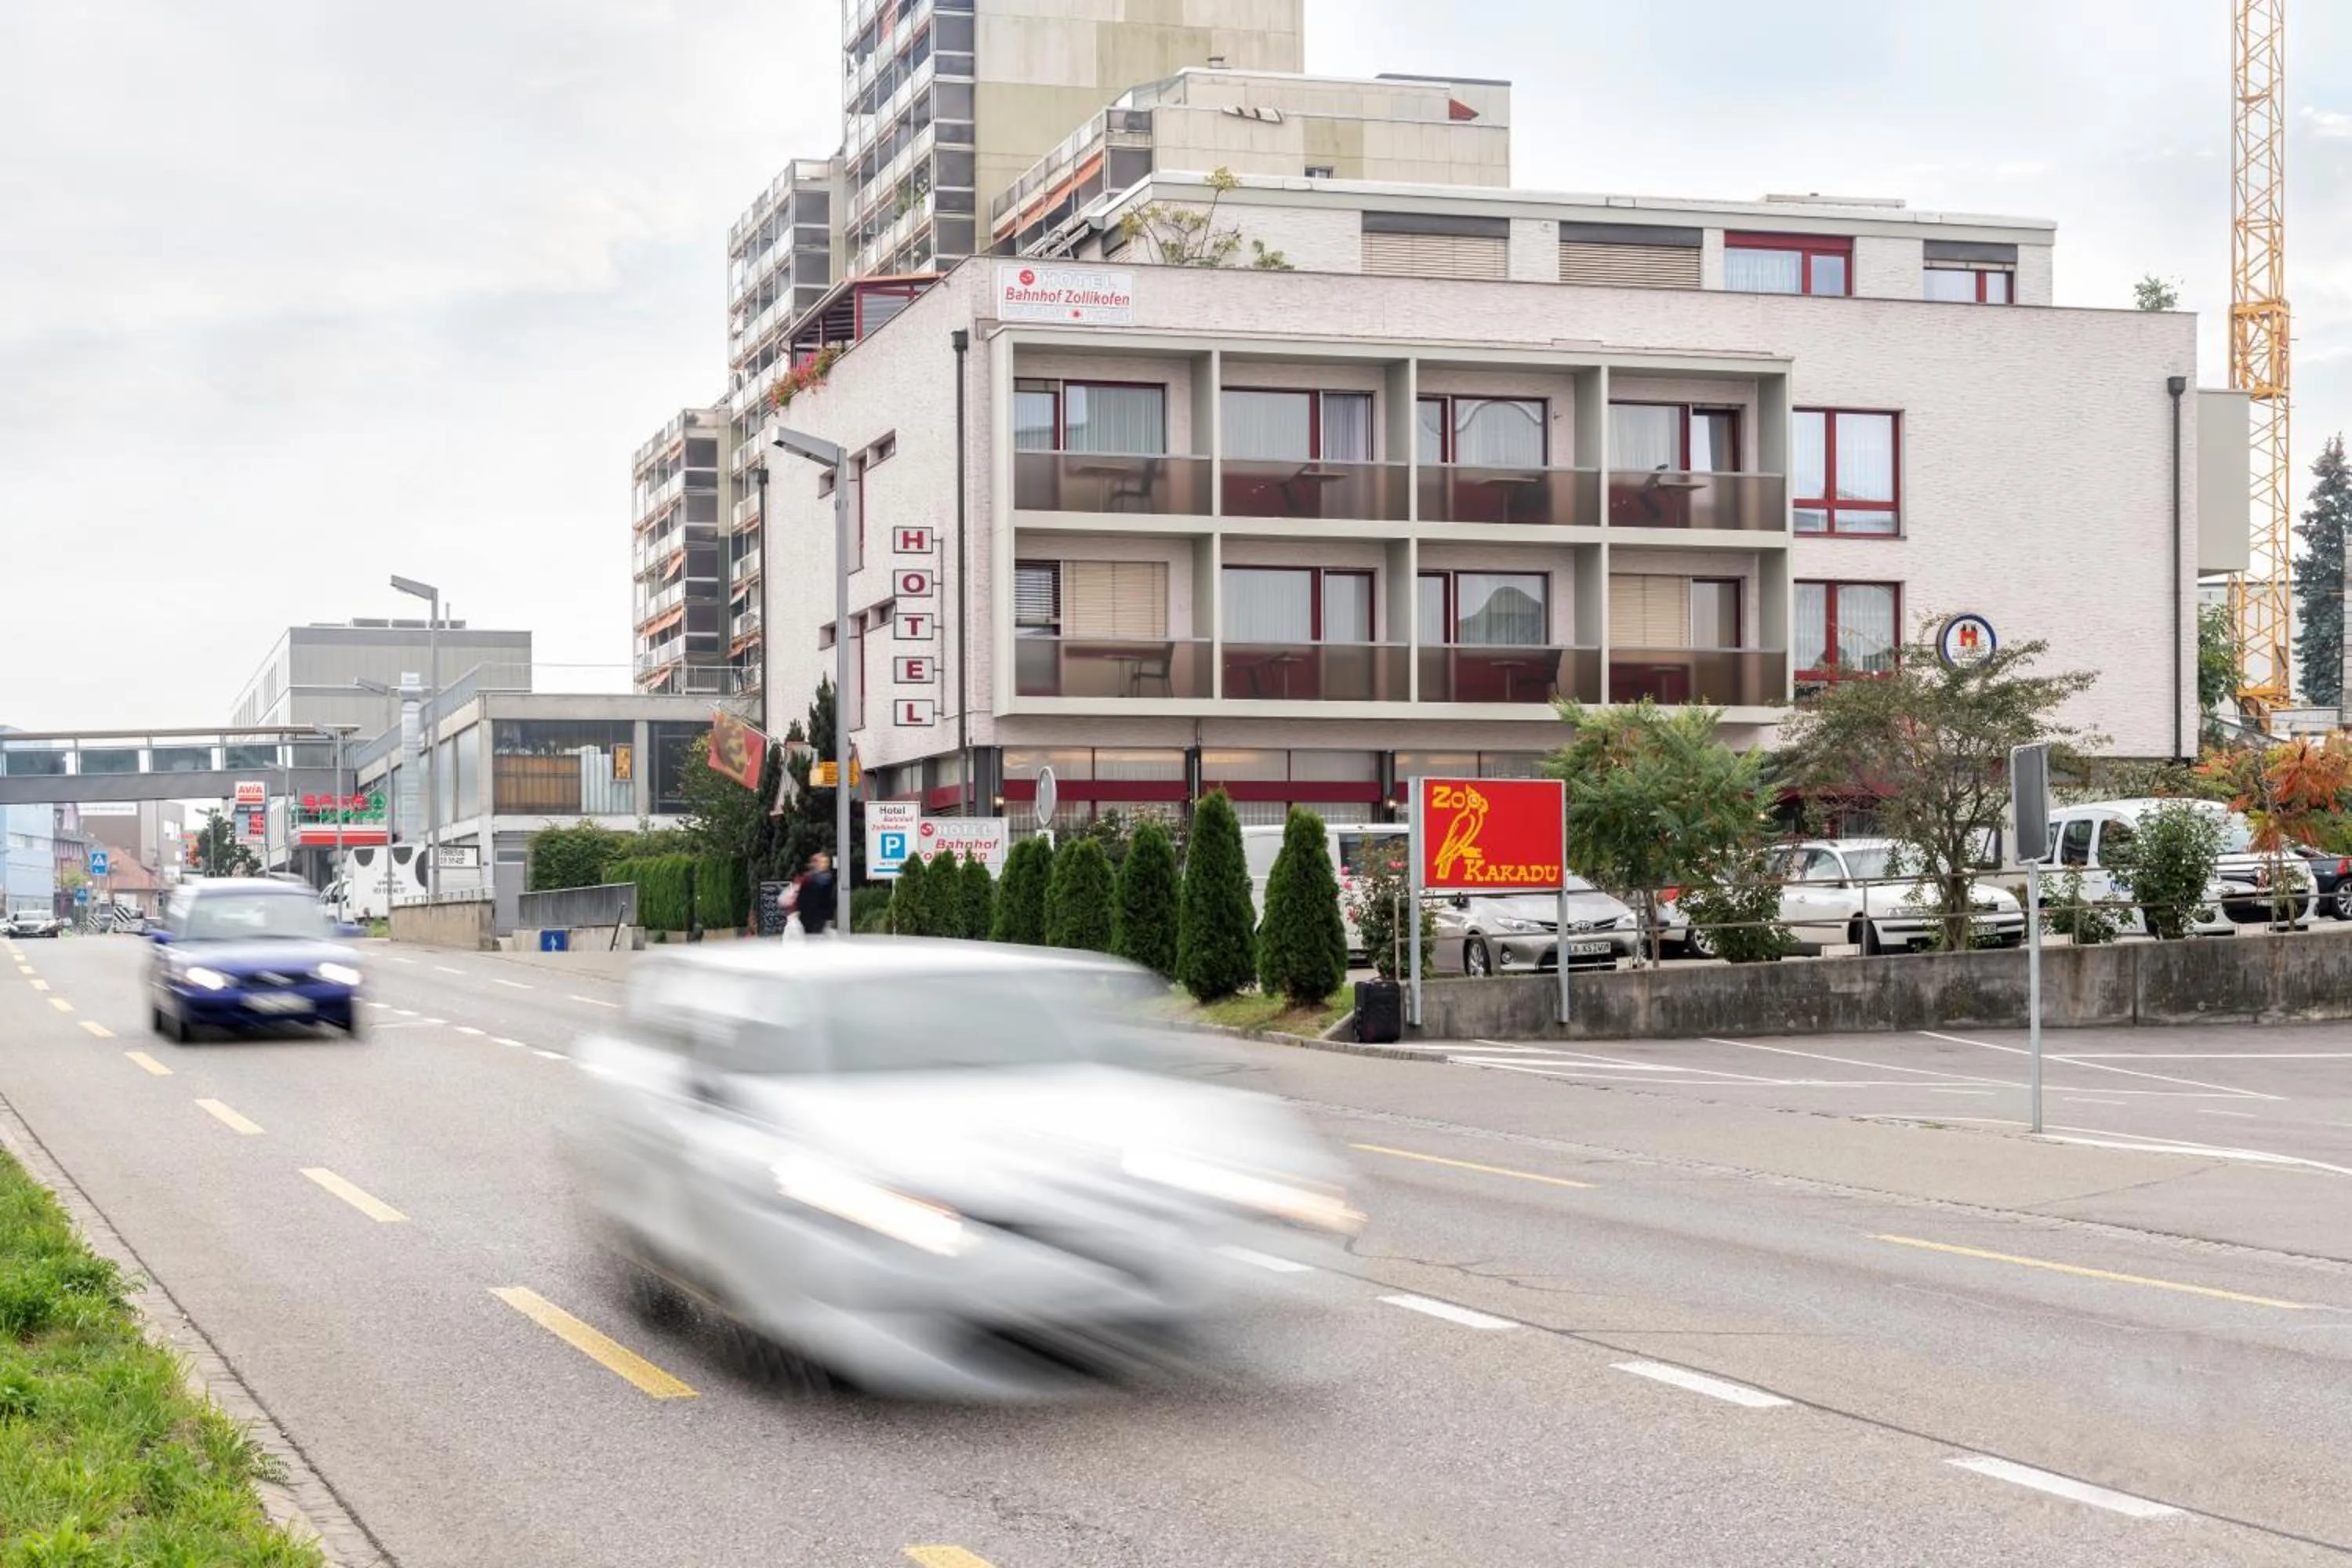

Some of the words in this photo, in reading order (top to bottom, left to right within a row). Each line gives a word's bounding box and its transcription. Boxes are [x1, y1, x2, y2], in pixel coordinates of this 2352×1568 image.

[1040, 270, 1116, 289] HOTEL
[1005, 286, 1062, 303] Bahnhof
[1065, 290, 1130, 306] Zollikofen
[902, 531, 925, 722] HOTEL
[879, 806, 906, 815] Hotel
[936, 824, 992, 836] HOTEL
[885, 836, 901, 857] P
[935, 838, 1000, 850] Bahnhof
